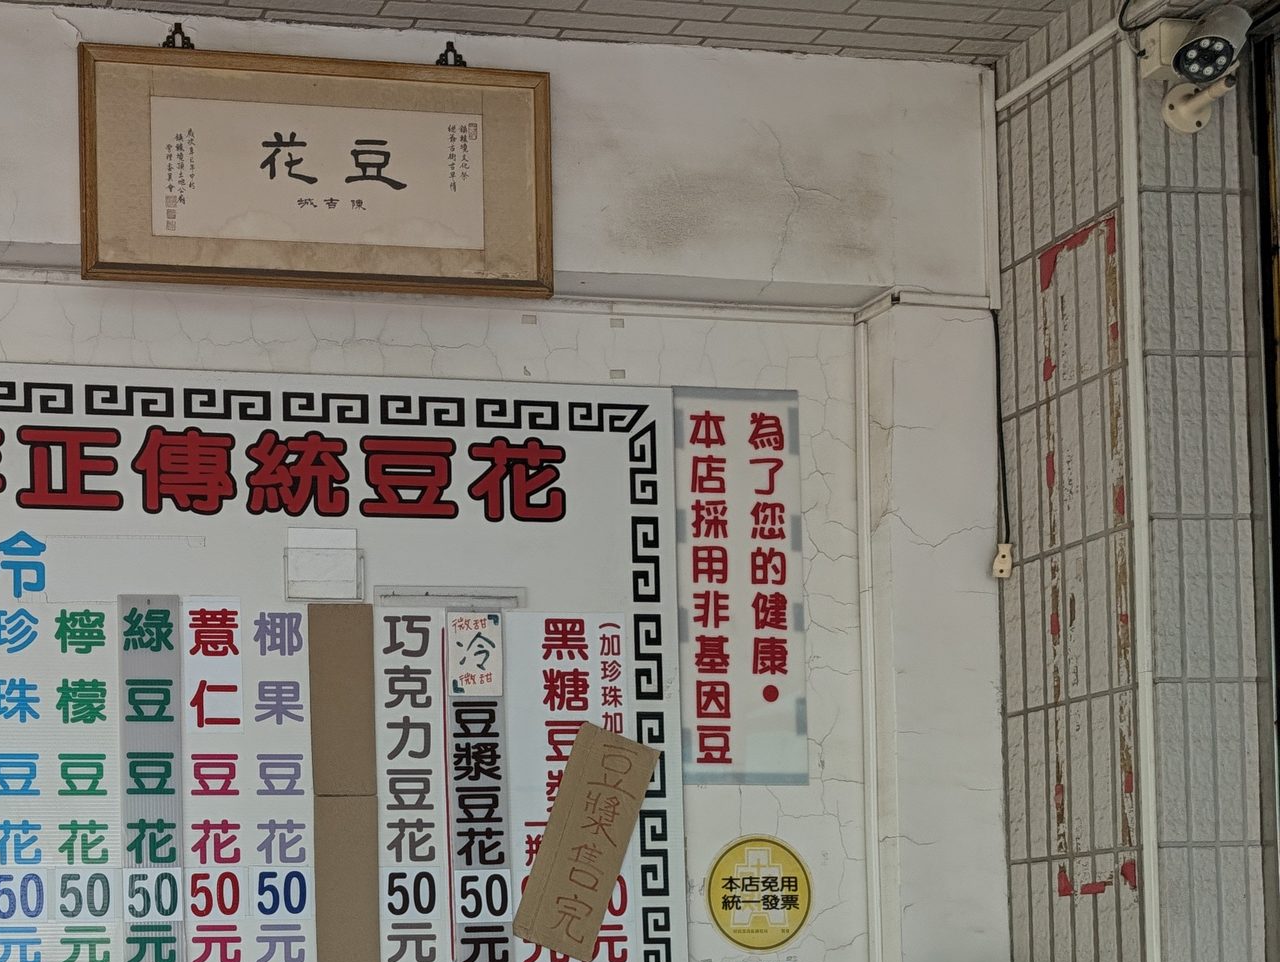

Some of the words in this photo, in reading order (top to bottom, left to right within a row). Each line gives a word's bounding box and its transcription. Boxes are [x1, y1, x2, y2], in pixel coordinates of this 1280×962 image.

[260, 131, 407, 190] 豆花
[689, 410, 733, 765] 本店採用非基因豆
[452, 617, 488, 633] 微甜
[456, 631, 496, 671] 冷
[459, 672, 493, 687] 微甜
[721, 876, 798, 892] 本店免用
[721, 894, 799, 911] 統一發票
